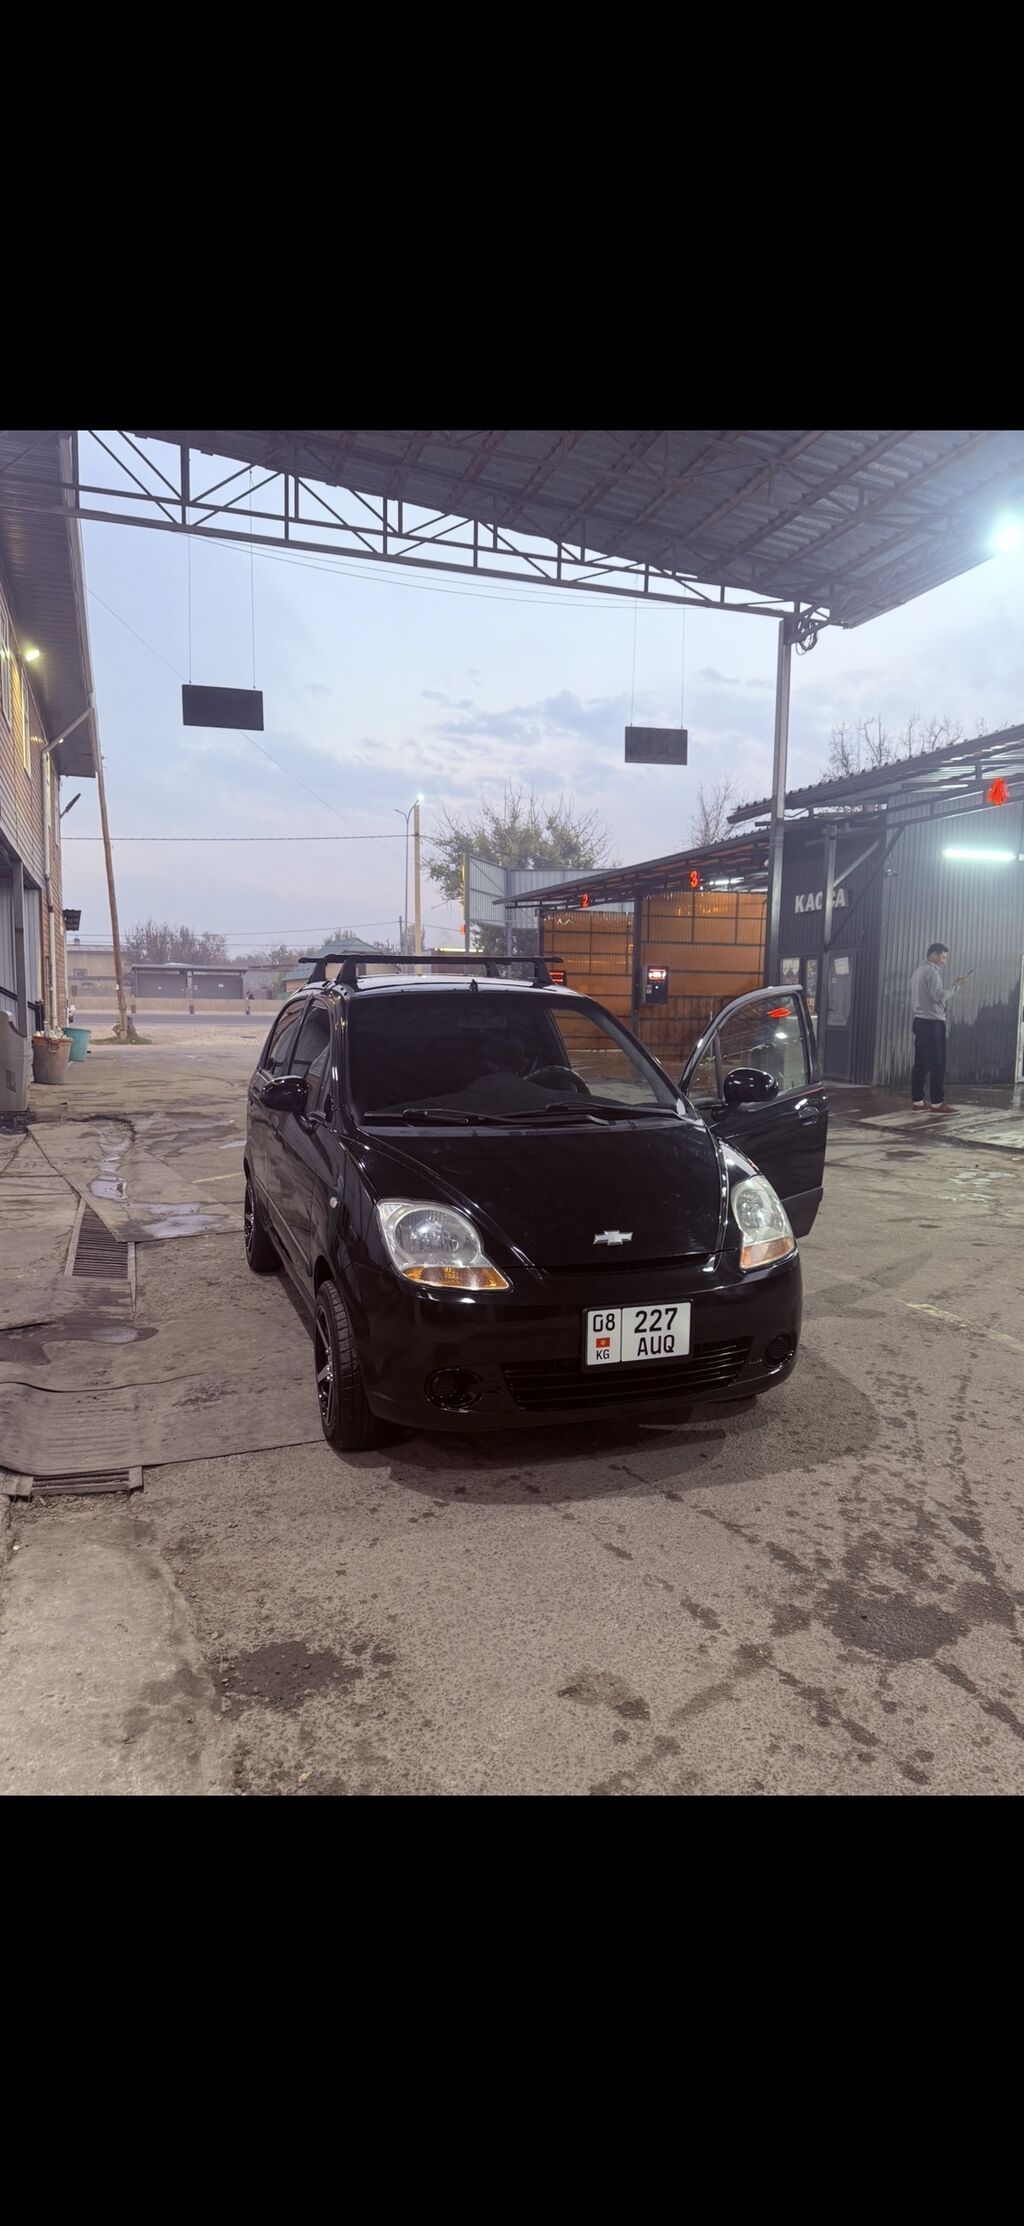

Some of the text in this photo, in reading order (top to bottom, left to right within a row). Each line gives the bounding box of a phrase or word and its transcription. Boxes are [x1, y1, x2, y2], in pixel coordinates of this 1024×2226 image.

[690, 870, 698, 888] 3
[581, 893, 589, 908] 2
[794, 888, 847, 913] КАСА
[593, 1313, 615, 1333] 08
[634, 1307, 678, 1334] 227
[596, 1349, 610, 1360] KG
[637, 1335, 675, 1357] AUQ
